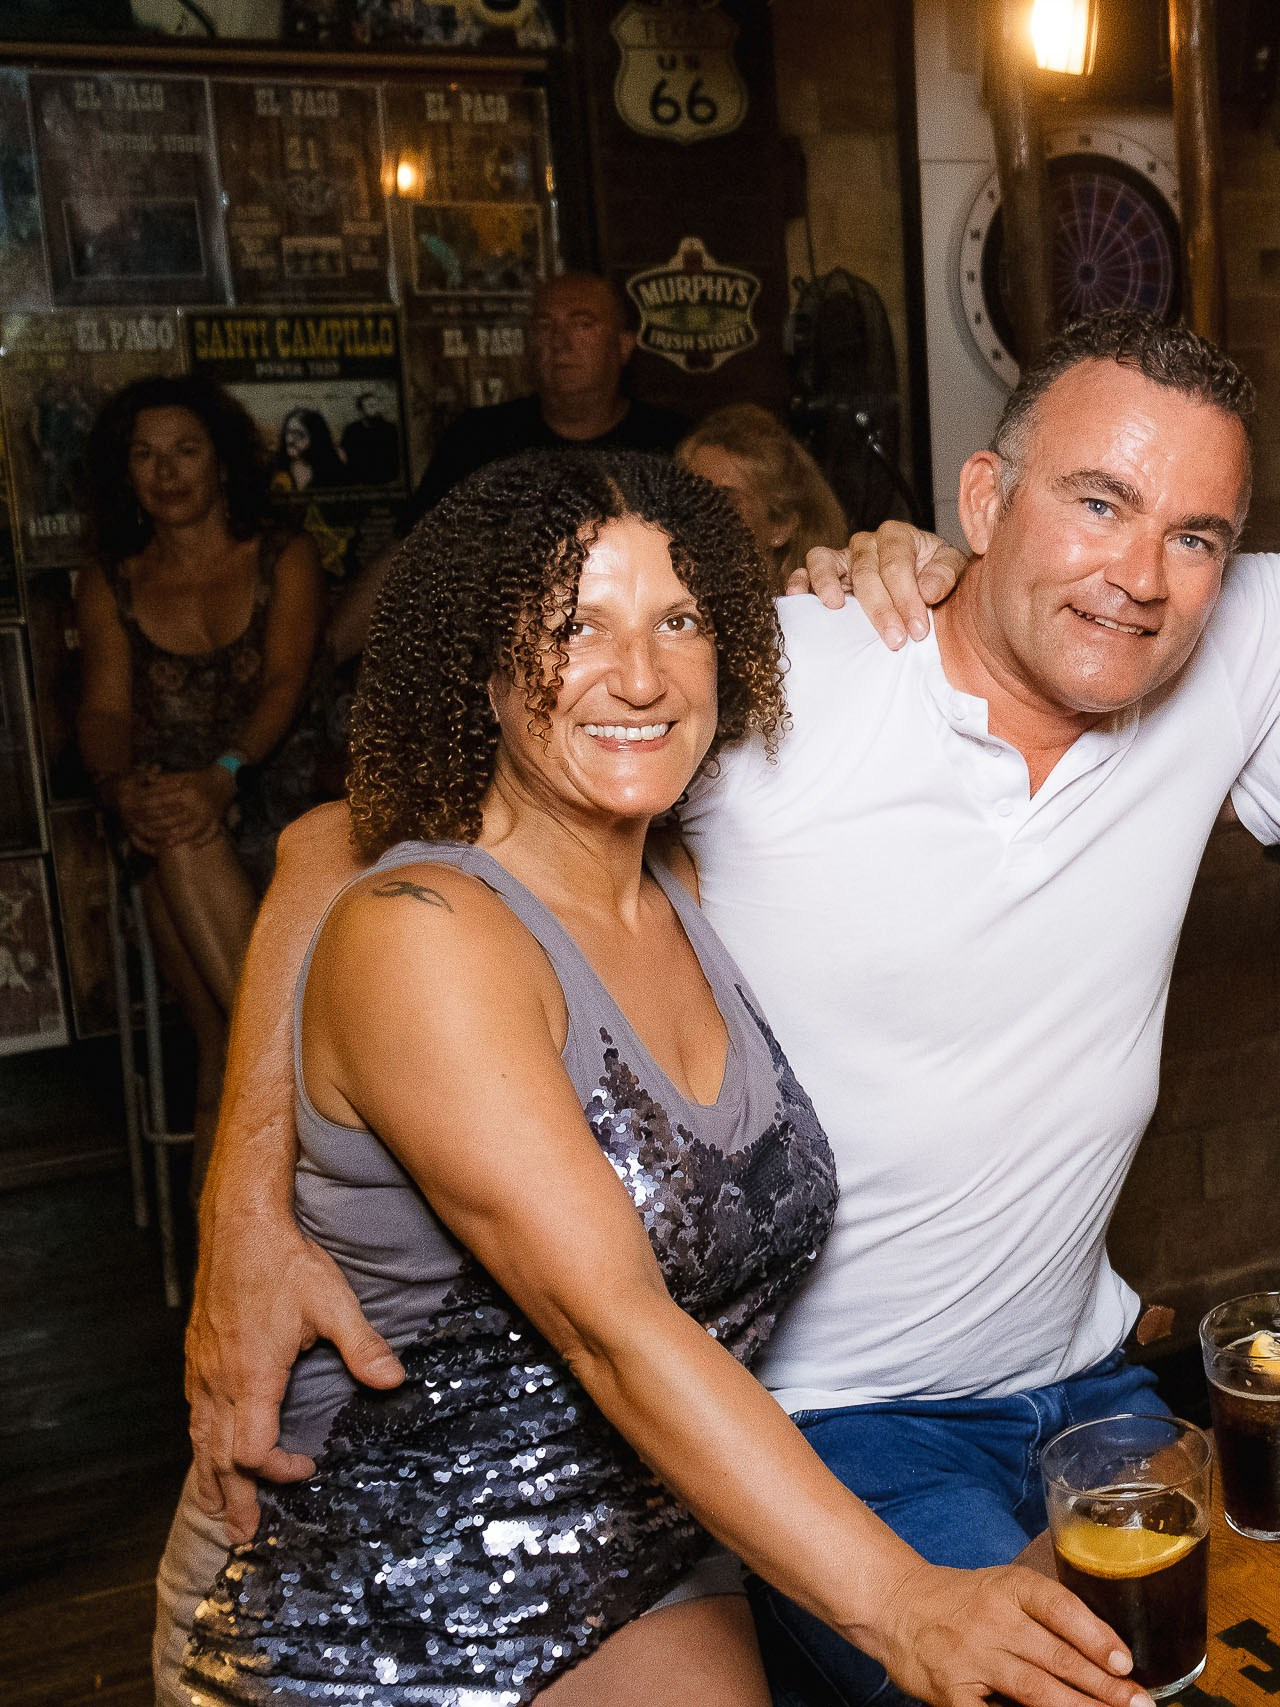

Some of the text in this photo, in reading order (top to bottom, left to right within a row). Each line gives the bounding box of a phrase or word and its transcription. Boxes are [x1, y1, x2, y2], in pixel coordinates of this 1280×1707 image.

[658, 53, 701, 71] US
[650, 78, 718, 125] 66
[76, 319, 106, 351] EL
[109, 316, 175, 351] PASO
[194, 317, 396, 361] SANTI CAMPILLO
[442, 327, 524, 357] EL PASO
